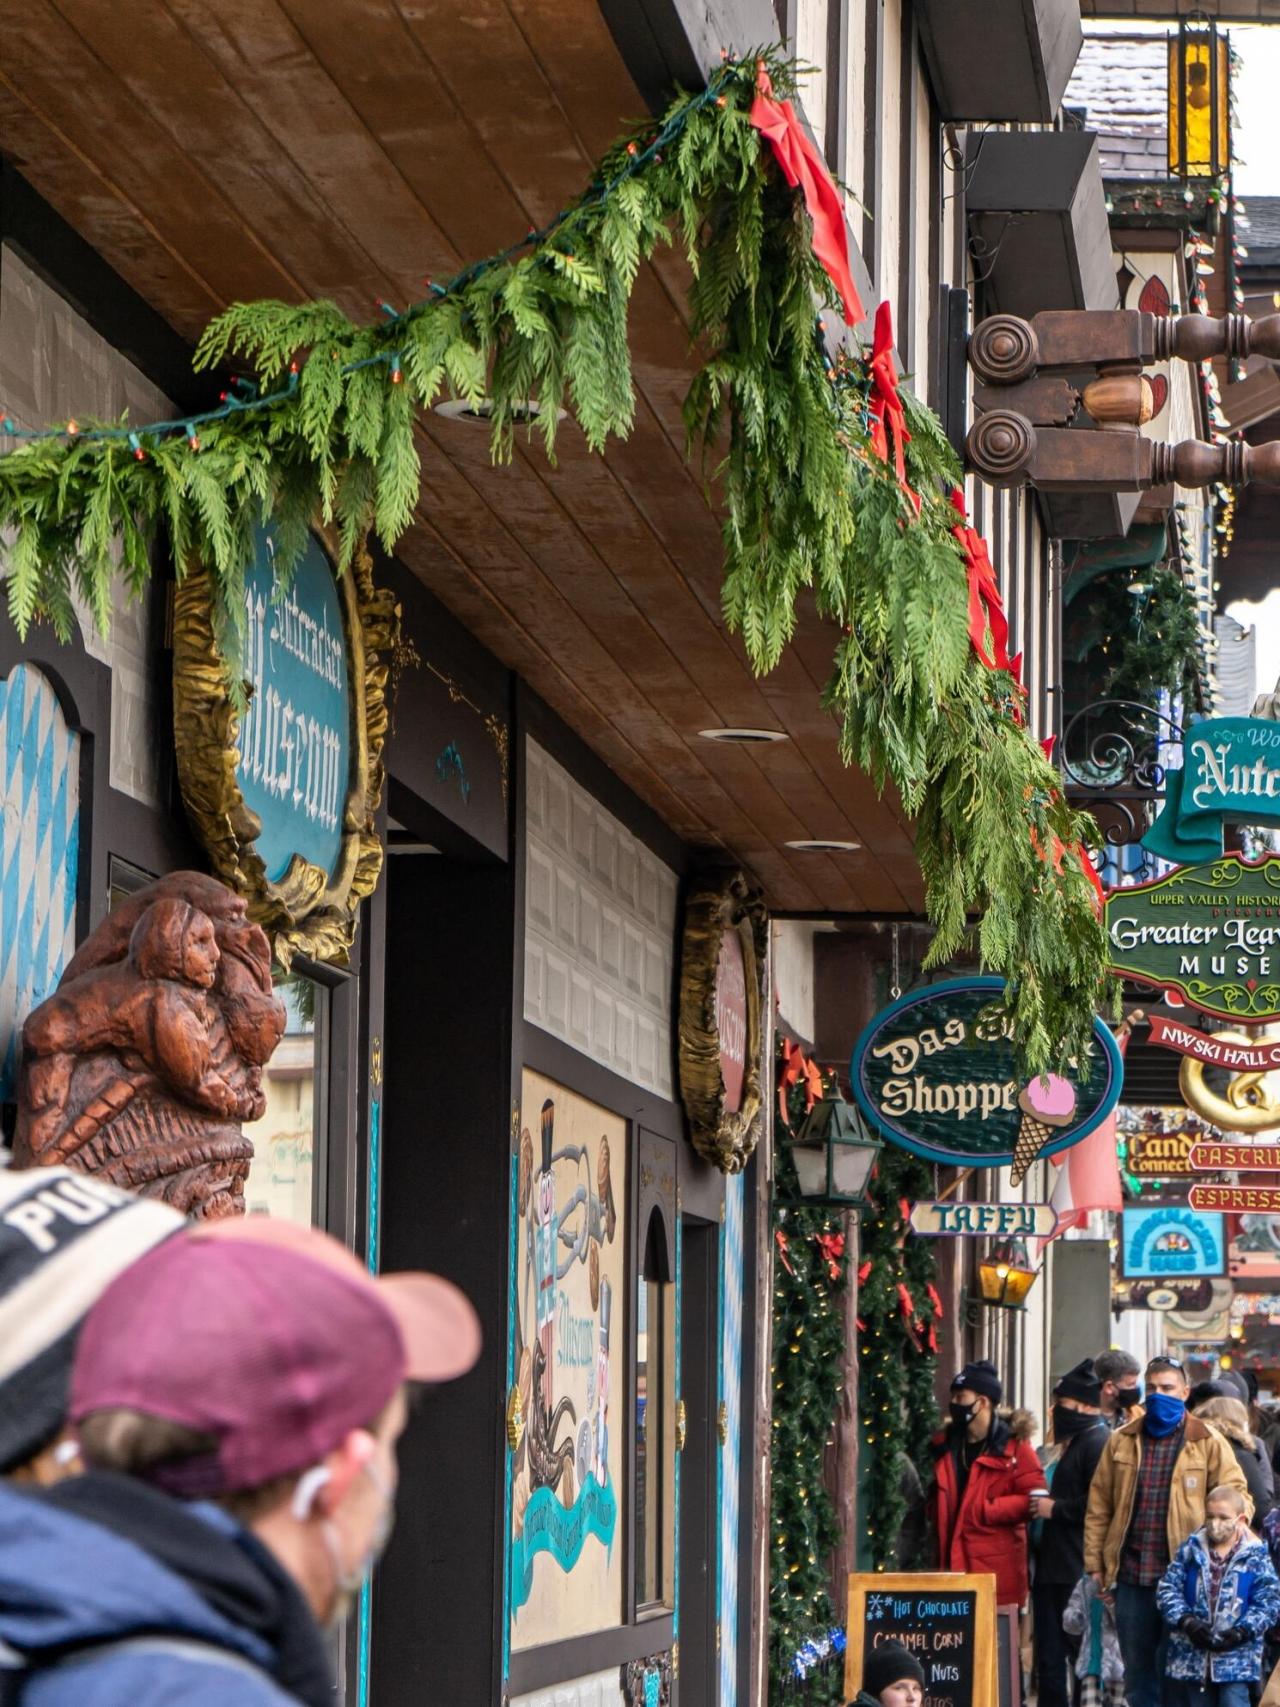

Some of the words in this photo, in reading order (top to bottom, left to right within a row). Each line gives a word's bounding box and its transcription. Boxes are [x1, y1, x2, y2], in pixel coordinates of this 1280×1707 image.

[1150, 894, 1185, 905] UPPER
[1188, 895, 1232, 906] VALLEY
[1110, 918, 1218, 950] Greater
[872, 1018, 967, 1075] Das
[1161, 1026, 1197, 1048] NW
[1193, 1039, 1220, 1060] SKI
[1223, 1048, 1268, 1066] HALL
[880, 1073, 1017, 1121] Shoppe
[1129, 1131, 1214, 1158] Cand
[1129, 1158, 1193, 1173] Connect
[930, 1204, 1037, 1234] TAFFY
[893, 1601, 911, 1618] HOT
[917, 1600, 970, 1618] CHOCOLATE
[873, 1631, 929, 1650] CAMEL
[933, 1631, 963, 1651] CORN
[931, 1663, 960, 1683] NUTS
